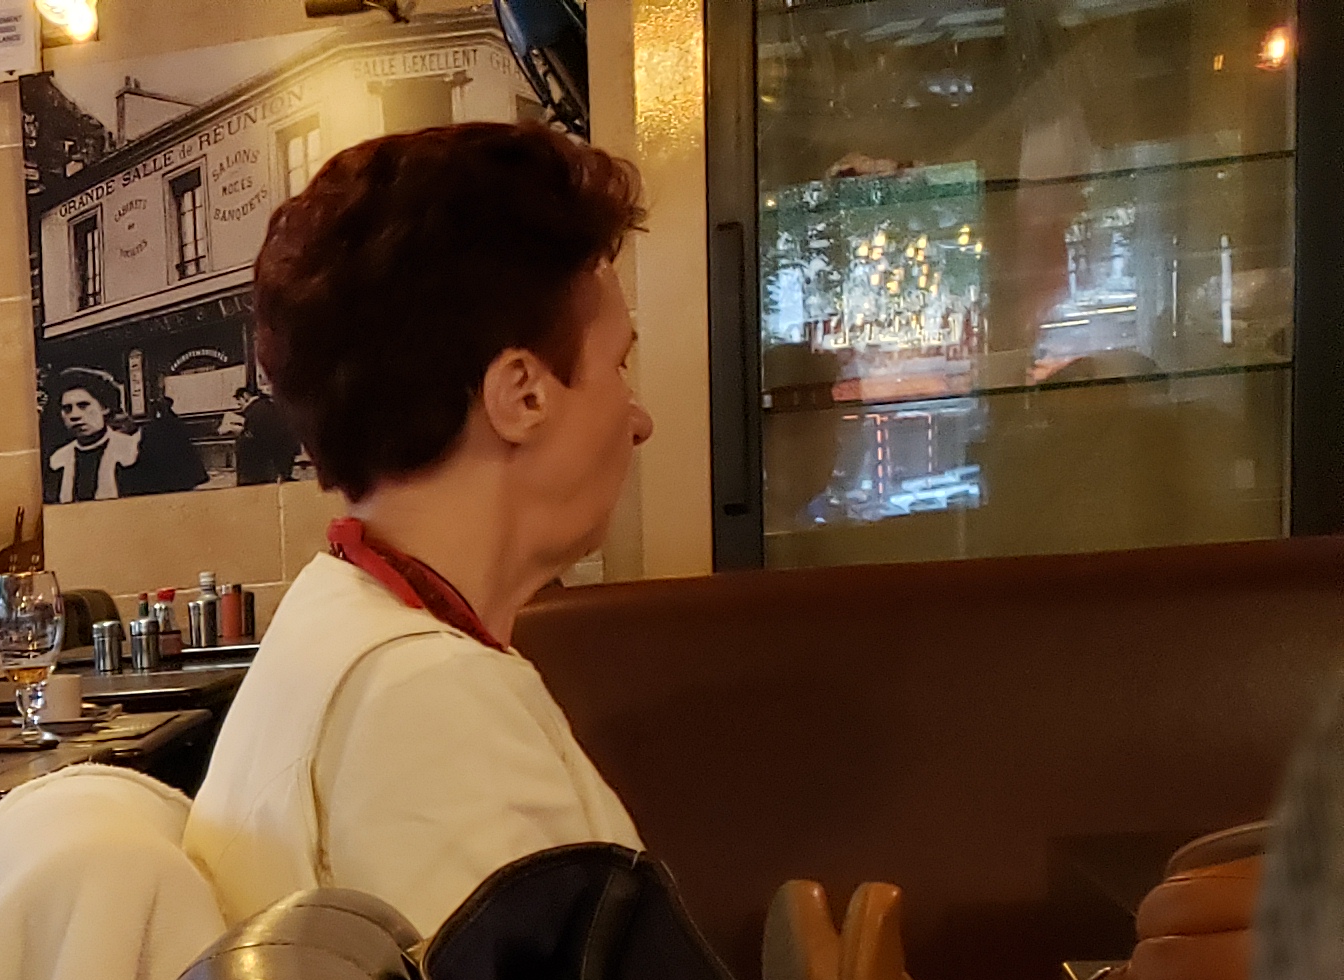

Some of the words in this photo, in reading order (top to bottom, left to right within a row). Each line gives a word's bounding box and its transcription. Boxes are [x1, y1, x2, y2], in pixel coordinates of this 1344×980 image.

[59, 179, 115, 218] GRANDE
[121, 149, 174, 188] SALLE
[178, 143, 193, 160] de
[212, 148, 261, 183] SALONS
[213, 183, 268, 223] BANQUETS
